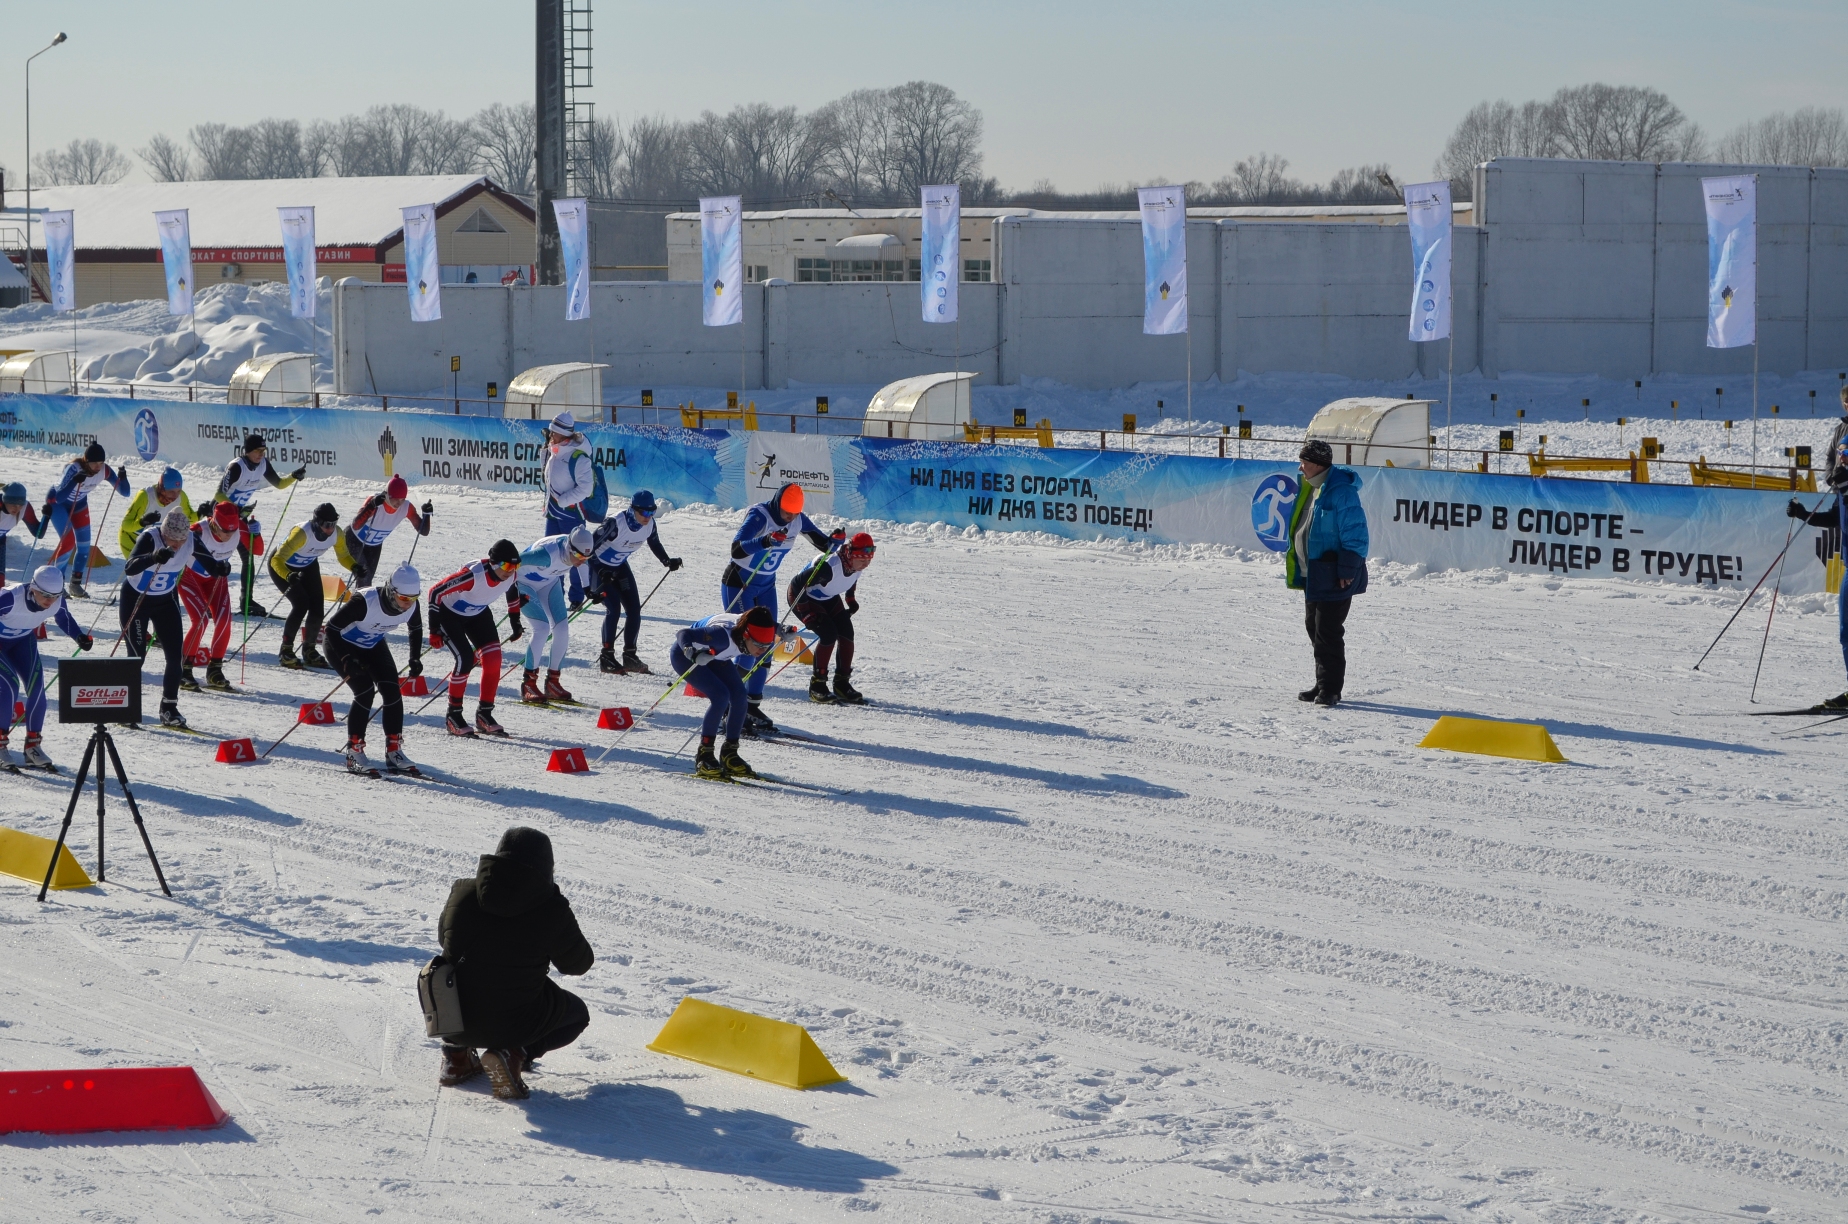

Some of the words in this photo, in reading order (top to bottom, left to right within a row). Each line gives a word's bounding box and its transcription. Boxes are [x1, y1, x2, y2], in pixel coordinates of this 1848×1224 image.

[190, 252, 215, 260] ОКАТ
[232, 252, 286, 260] СПОРТИВН
[318, 251, 351, 259] ГАЗИН
[488, 388, 496, 396] 30
[643, 396, 652, 404] 28
[728, 399, 736, 407] 27
[817, 403, 827, 412] 26
[1015, 415, 1025, 425] 24
[1123, 421, 1135, 431] 23
[198, 424, 240, 443] ПОБЕДА
[253, 427, 295, 443] СПОРТЕ
[1240, 428, 1251, 438] 22
[1501, 438, 1512, 448] 20
[281, 448, 288, 462] В
[292, 448, 337, 466] РАБОТЕ!
[421, 436, 443, 456] VIII
[447, 438, 509, 460] ЗИМНЯЯ
[513, 443, 627, 471] СПААДА
[1646, 446, 1655, 456] 19
[1798, 455, 1809, 465] 18
[422, 460, 451, 478] ПАО
[456, 463, 482, 481] «НК
[780, 469, 830, 481] РОСНЕФТЬ
[910, 467, 934, 486] НИ
[939, 469, 976, 492] ДНЯ
[981, 472, 1015, 493] БЕЗ
[1021, 476, 1098, 502] СПОРТА,
[968, 495, 993, 516] НИ
[998, 498, 1036, 521] ДНЯ
[1042, 501, 1077, 522] БЕЗ
[1084, 504, 1153, 532] ПОБЕД!
[1393, 498, 1482, 531] ЛИДЕР
[1492, 505, 1508, 530] В
[1517, 508, 1624, 540] СПОРТЕ
[364, 530, 389, 543] 15
[610, 552, 631, 564] 9
[763, 551, 783, 571] 3
[1509, 539, 1602, 573] ЛИДЕР
[1612, 547, 1629, 573] В
[1640, 549, 1743, 584] ТРУДЕ!
[149, 573, 169, 591] 8
[77, 688, 127, 697] SoftLab
[408, 678, 416, 693] 7
[314, 706, 325, 721] 6
[613, 710, 625, 725] 3
[232, 742, 246, 759] 2
[565, 753, 577, 770] 1
